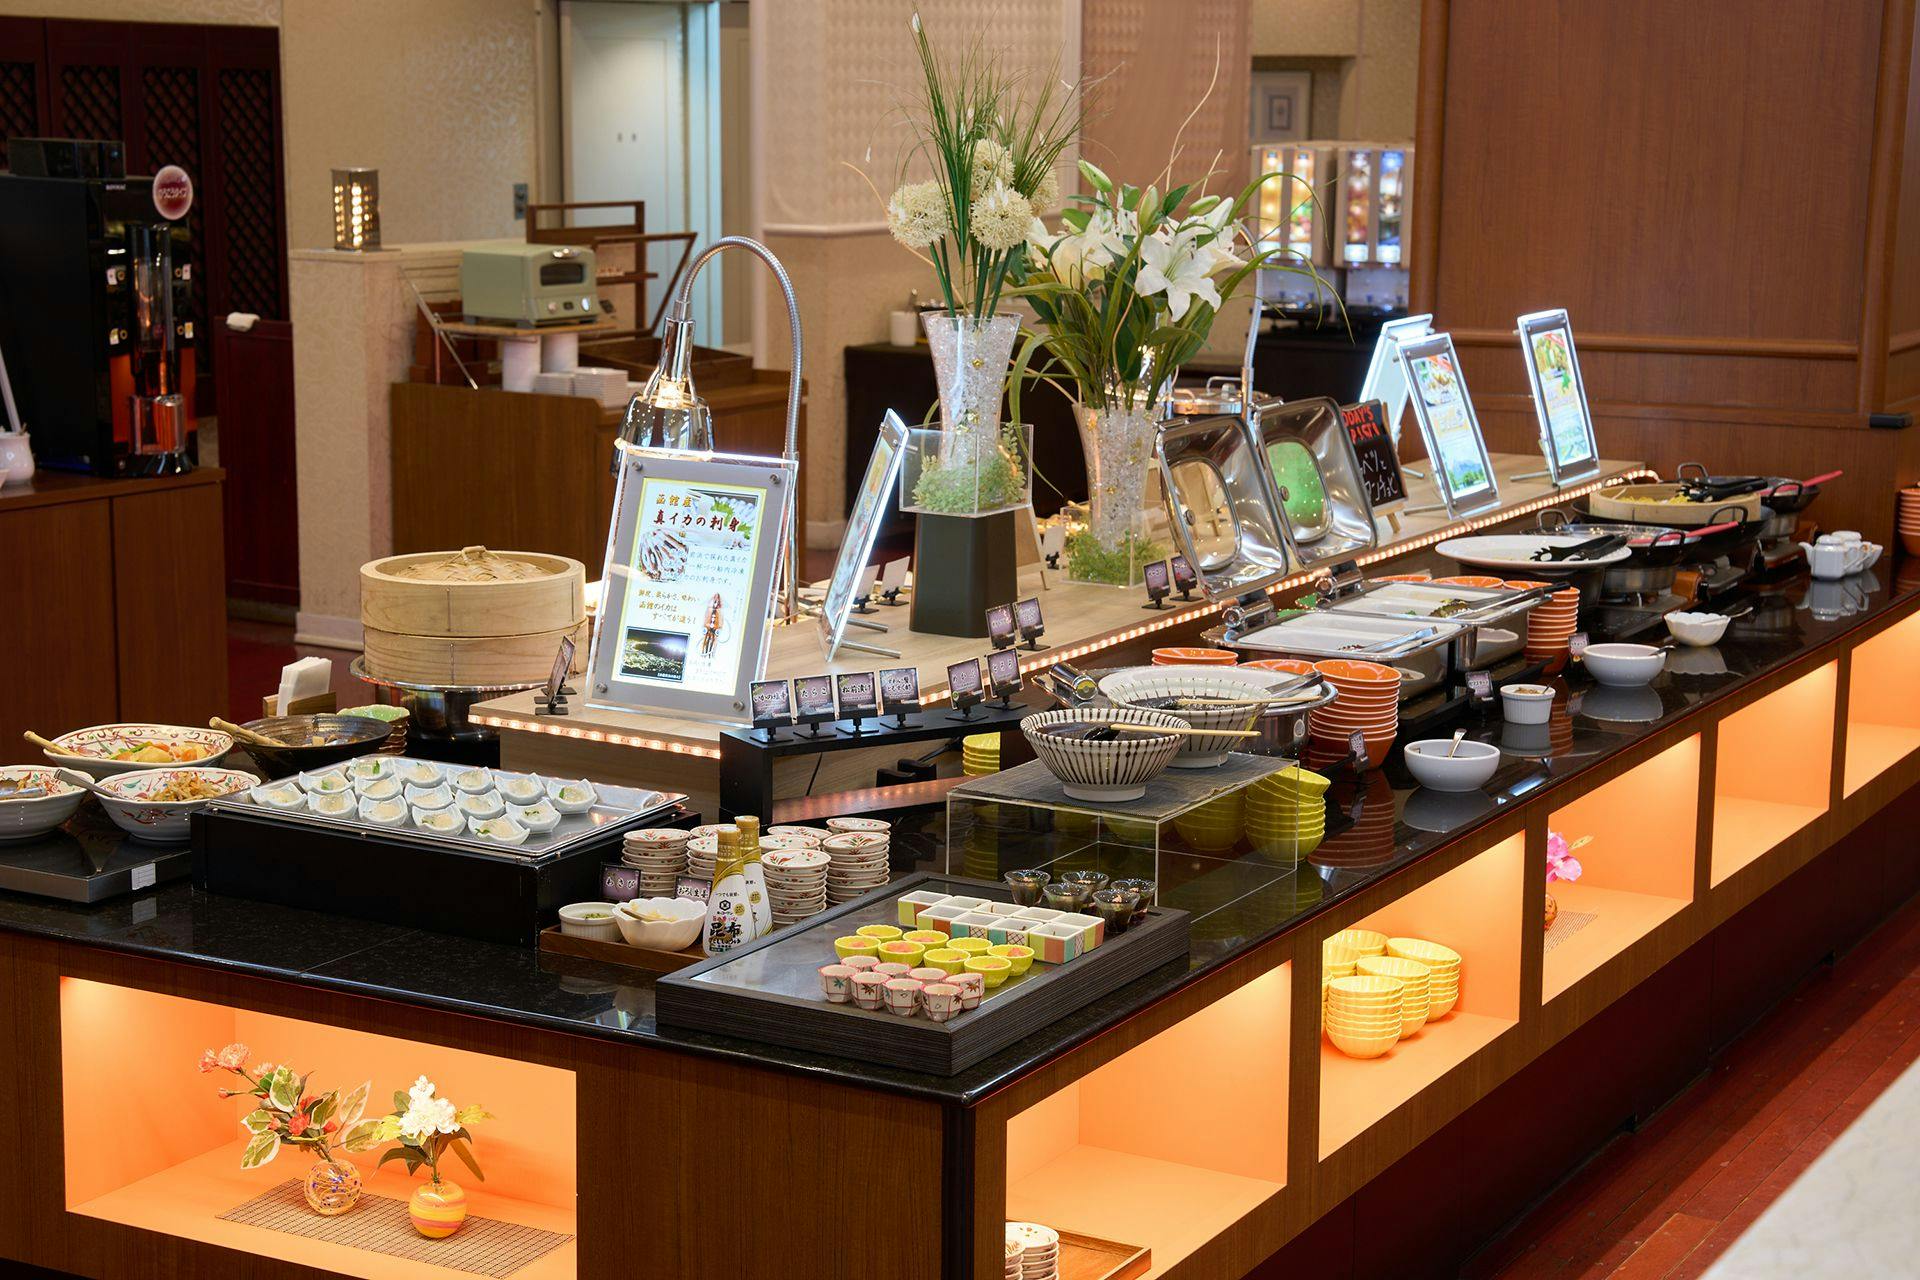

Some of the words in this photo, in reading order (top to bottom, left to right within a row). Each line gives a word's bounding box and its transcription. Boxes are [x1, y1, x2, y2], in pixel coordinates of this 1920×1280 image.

[1342, 405, 1374, 428] ODAY'S
[653, 509, 740, 532] 真イカの刺身
[800, 686, 828, 698] たらこ
